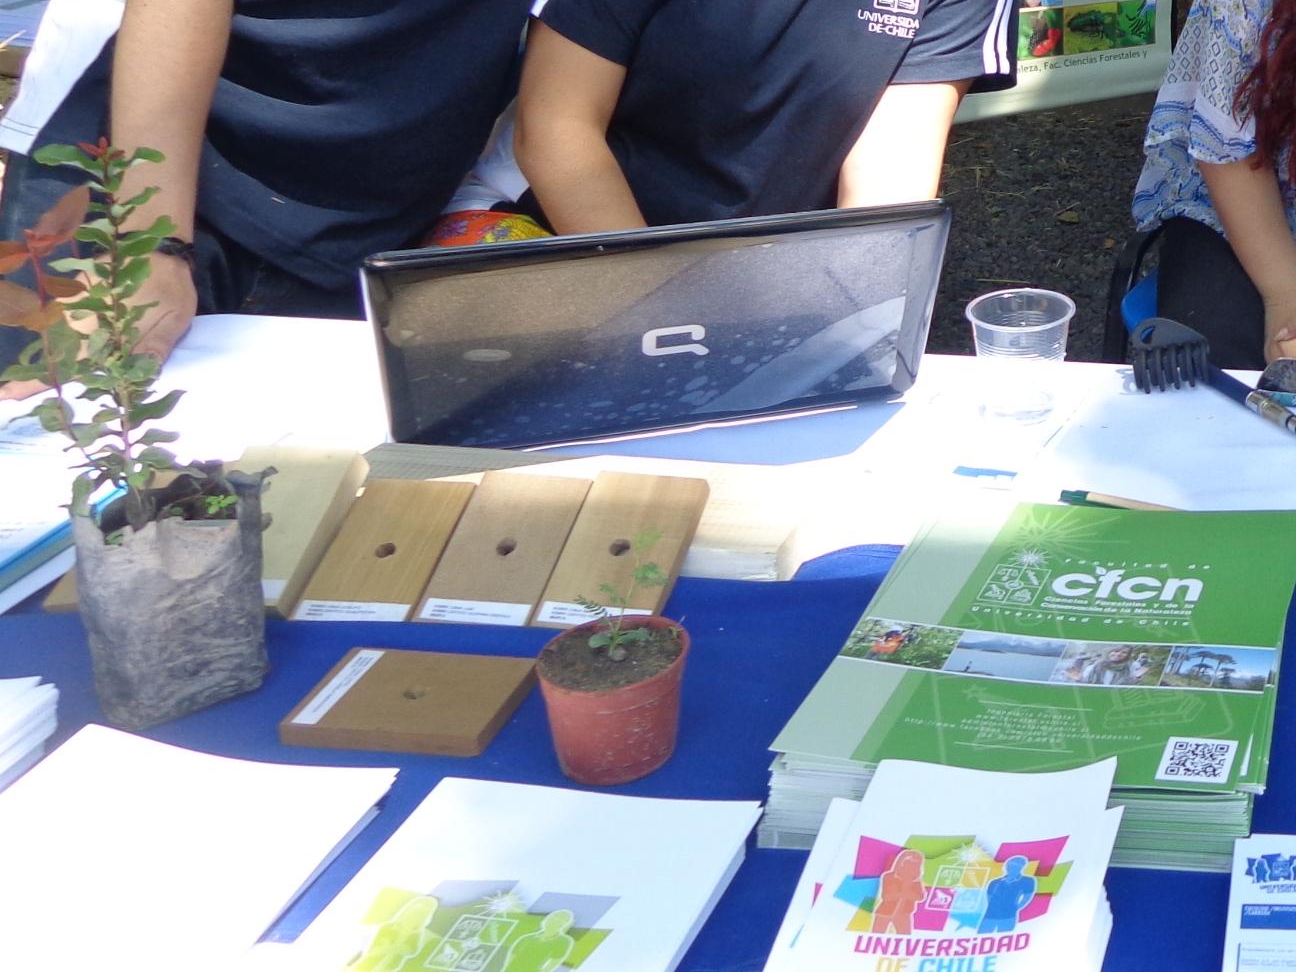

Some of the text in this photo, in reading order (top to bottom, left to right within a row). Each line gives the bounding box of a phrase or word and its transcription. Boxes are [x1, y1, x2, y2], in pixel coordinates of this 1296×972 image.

[868, 22, 917, 40] DE CHILE
[1043, 61, 1063, 71] Fac.
[1063, 56, 1098, 69] Ciencias
[1099, 50, 1141, 63] Forestales
[1142, 49, 1149, 60] y
